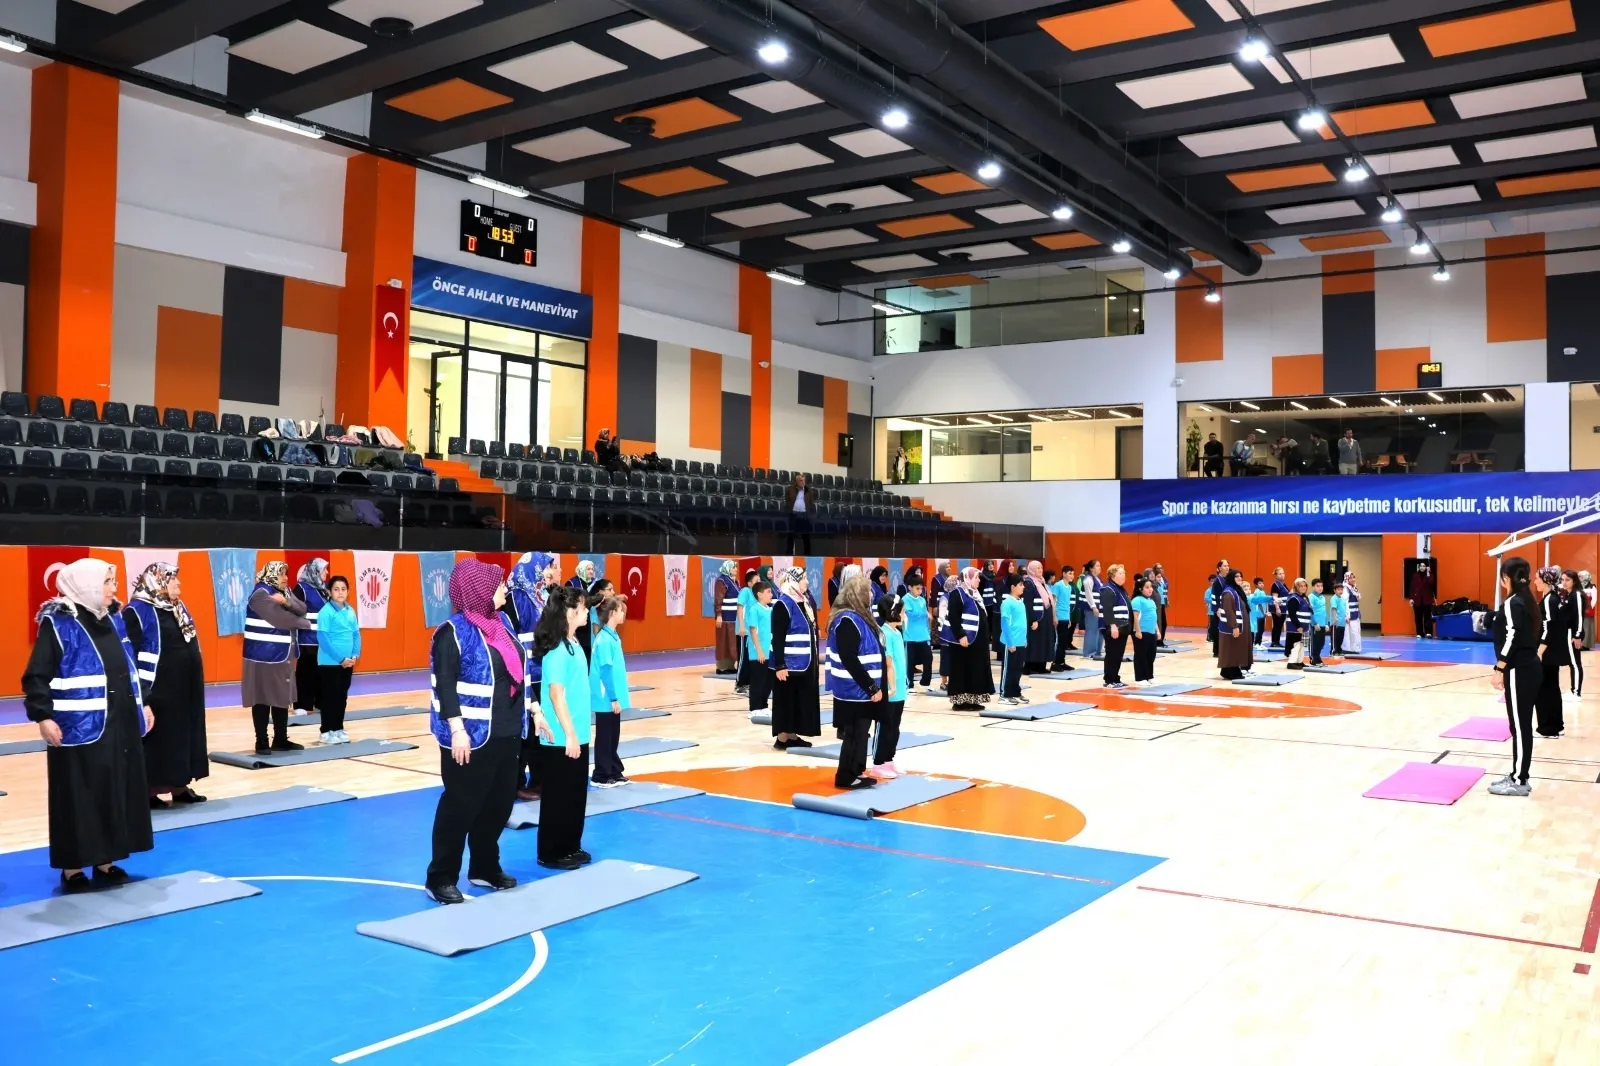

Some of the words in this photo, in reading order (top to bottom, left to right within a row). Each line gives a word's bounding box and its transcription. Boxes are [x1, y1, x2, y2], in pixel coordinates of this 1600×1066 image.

[474, 204, 481, 218] 0
[480, 216, 494, 227] HOME
[509, 222, 522, 234] GUEST
[527, 218, 534, 231] 0
[468, 236, 475, 251] 0
[524, 250, 532, 264] 0
[432, 276, 466, 297] ÖNCE
[466, 287, 505, 305] AHLAK
[505, 294, 520, 308] VE
[520, 299, 579, 320] MANEVİYAT
[1162, 500, 1190, 517] Spor
[1192, 501, 1208, 515] ne
[1211, 499, 1267, 515] kazanma
[1270, 498, 1300, 514] hırsı
[1303, 500, 1320, 514] ne
[1323, 498, 1390, 516] kaybetme
[1394, 497, 1482, 514] korkusudur,
[1485, 496, 1510, 513] tek
[1513, 495, 1590, 515] kelimeyle
